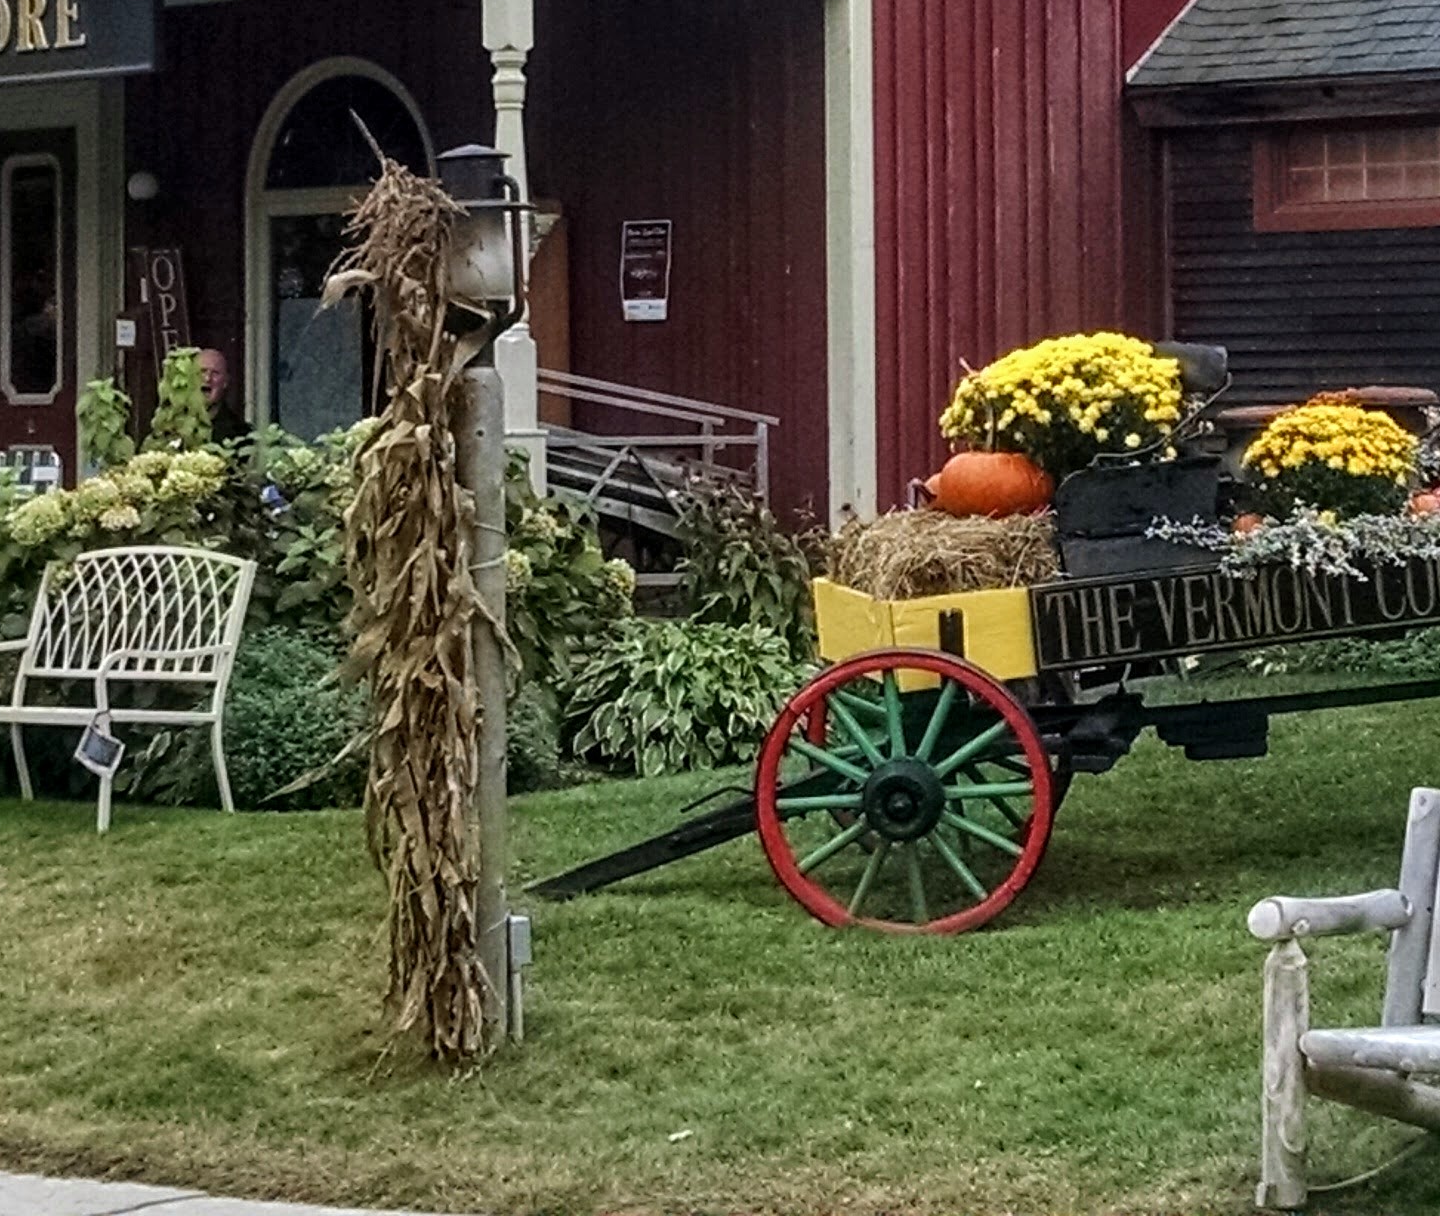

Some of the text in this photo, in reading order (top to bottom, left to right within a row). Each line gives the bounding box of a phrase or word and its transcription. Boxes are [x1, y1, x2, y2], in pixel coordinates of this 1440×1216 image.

[152, 255, 178, 352] OPE
[1045, 583, 1142, 660] THE
[1152, 564, 1357, 646] VERMONT
